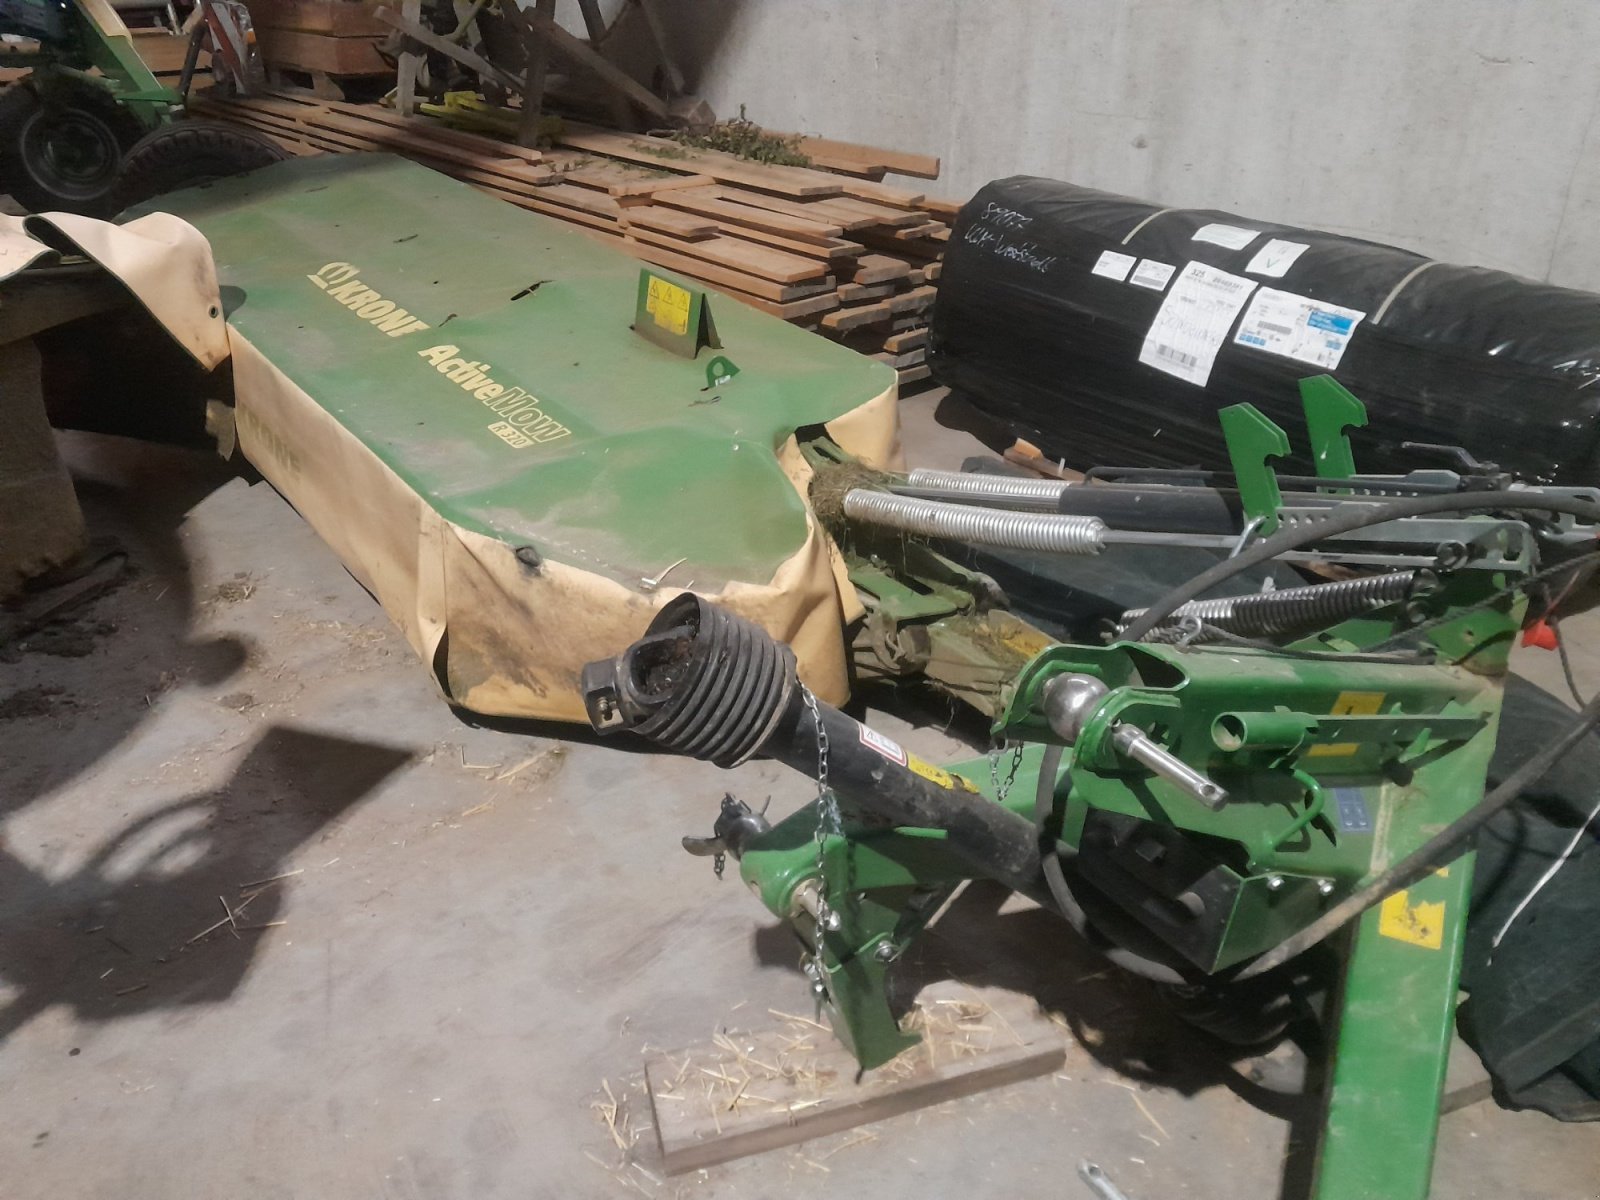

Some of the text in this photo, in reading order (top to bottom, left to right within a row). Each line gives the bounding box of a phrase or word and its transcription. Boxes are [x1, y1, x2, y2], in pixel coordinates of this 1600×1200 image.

[327, 279, 431, 338] KRONE
[418, 344, 572, 443] ActiveMow
[492, 424, 528, 446] R 320
